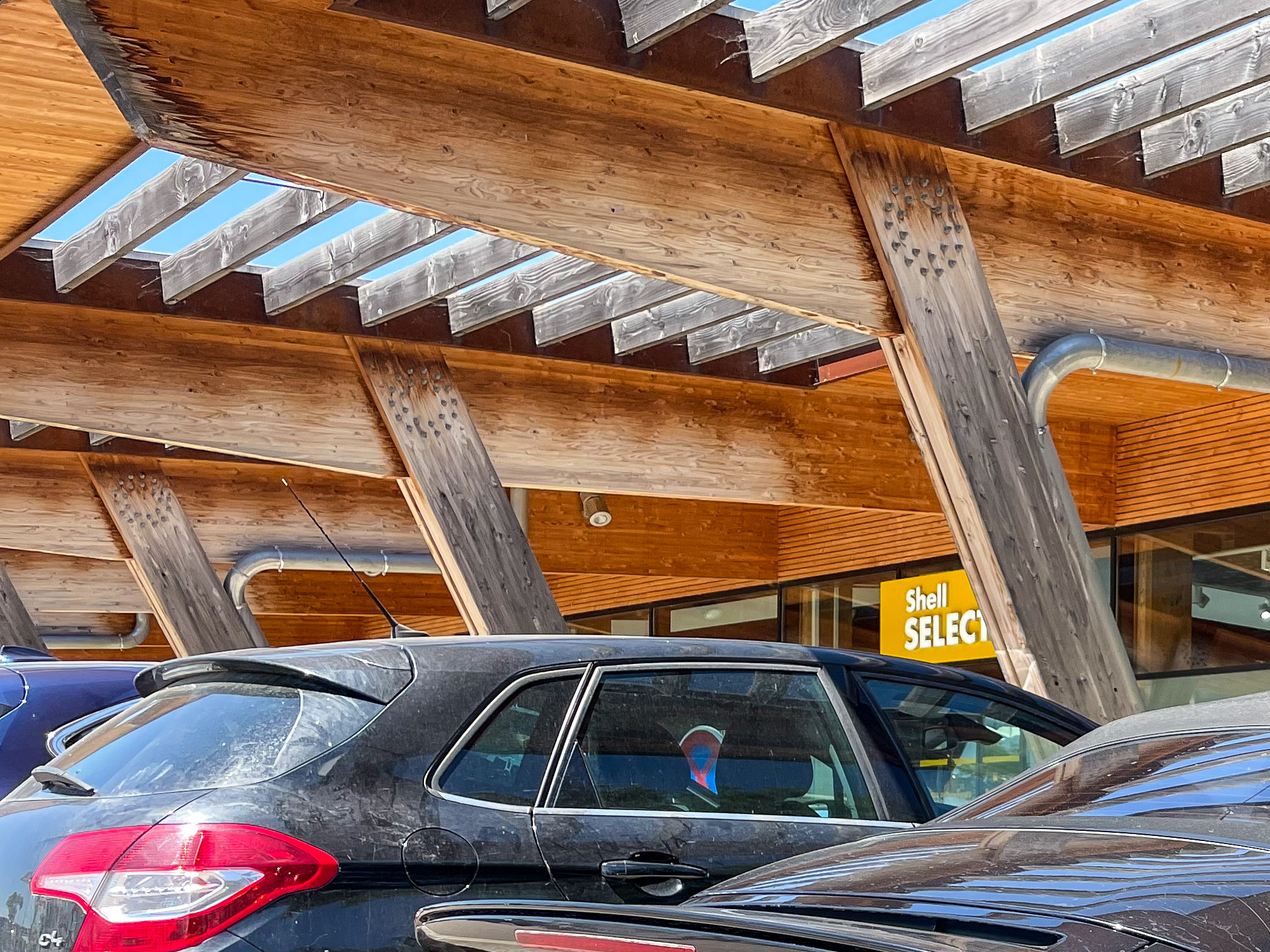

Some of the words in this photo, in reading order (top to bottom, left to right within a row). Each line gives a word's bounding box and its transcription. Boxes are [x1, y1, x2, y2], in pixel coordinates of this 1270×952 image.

[905, 582, 948, 613] Shell
[904, 608, 989, 651] SELECT
[38, 930, 66, 949] C4
